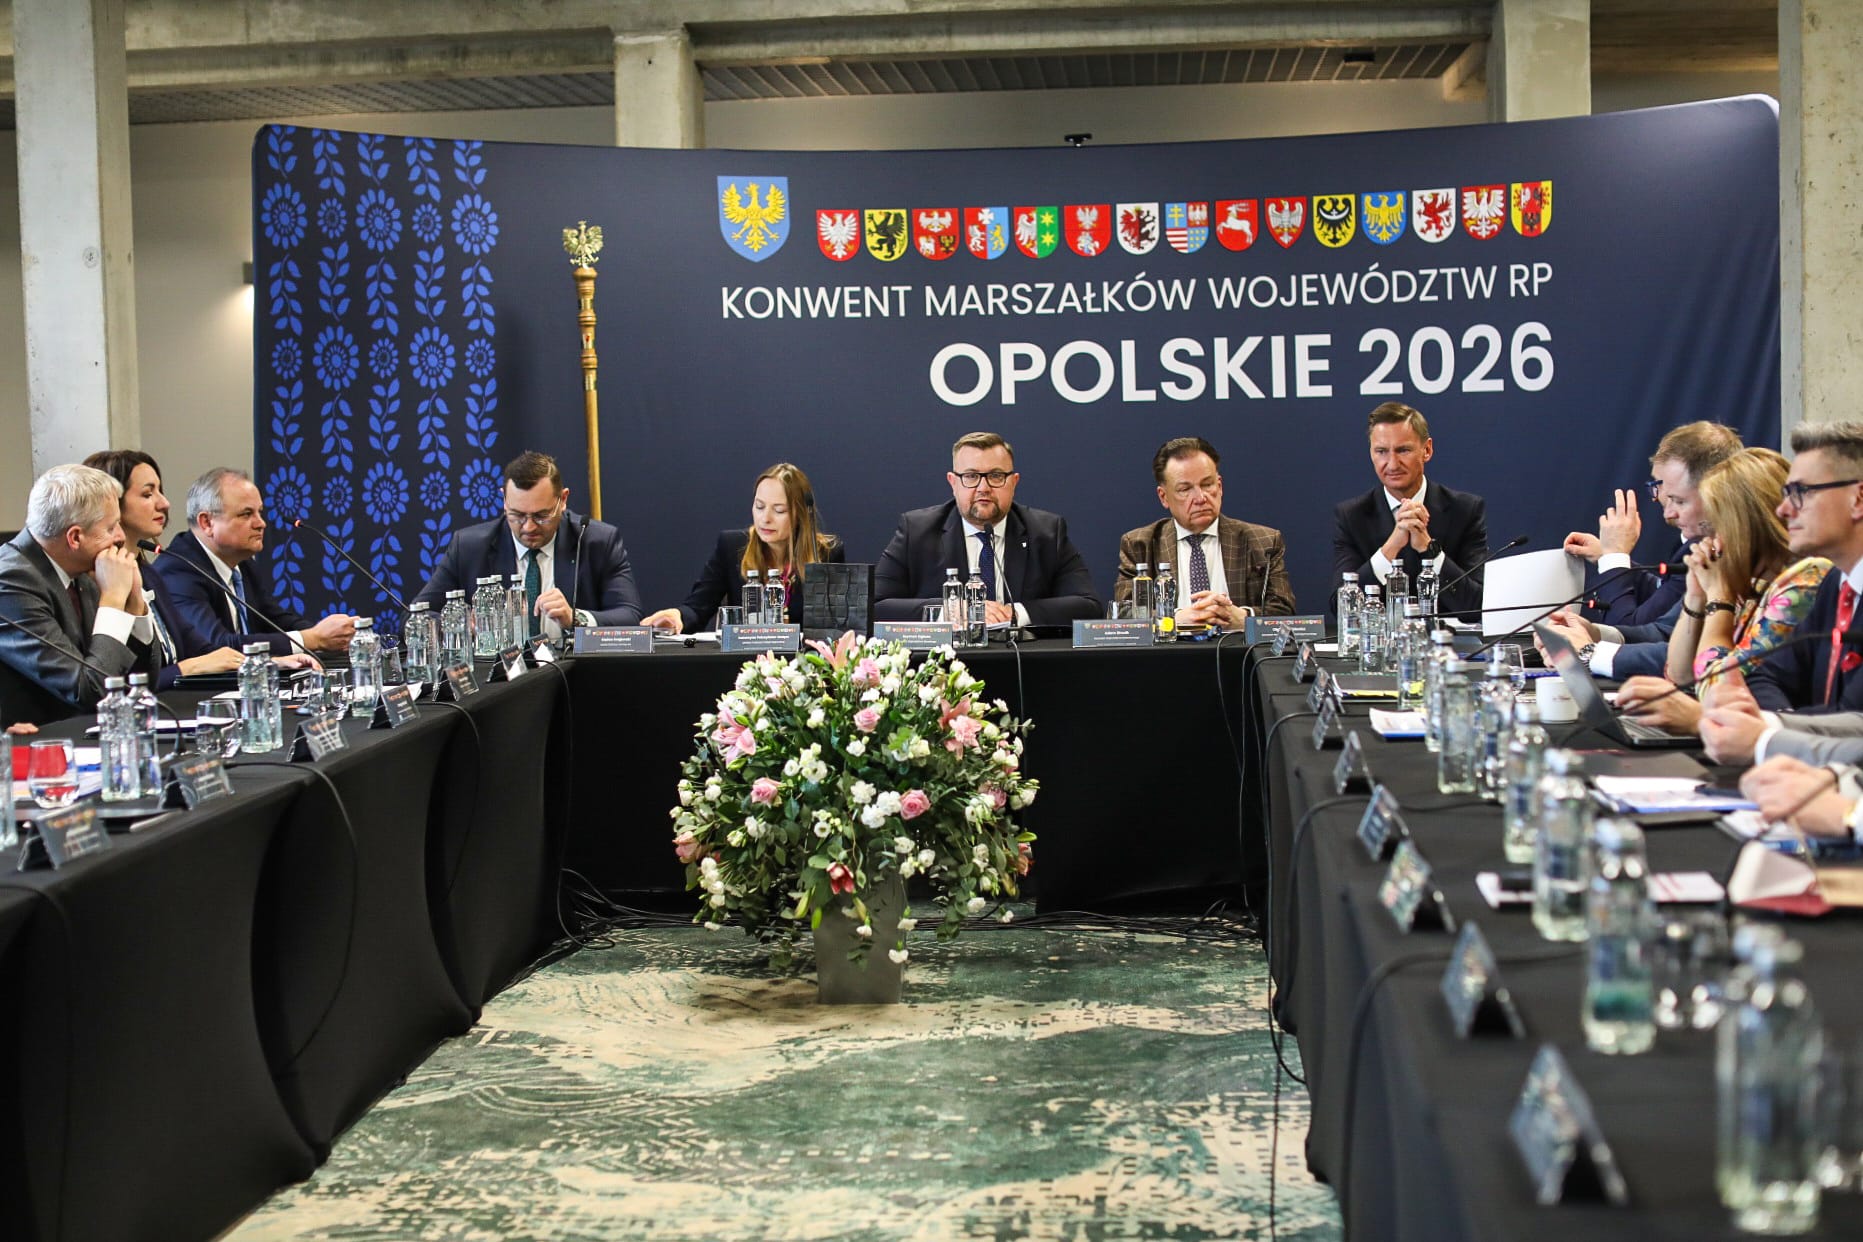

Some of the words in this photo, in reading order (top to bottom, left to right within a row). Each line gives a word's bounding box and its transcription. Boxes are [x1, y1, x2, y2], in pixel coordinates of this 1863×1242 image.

[721, 285, 913, 319] KONWENT
[925, 271, 1197, 317] MARSZAŁKÓW
[1207, 262, 1498, 309] WOJEWÓDZTW
[1509, 262, 1553, 297] RP
[929, 333, 1333, 406] OPOLSKIE
[1358, 321, 1554, 395] 2026
